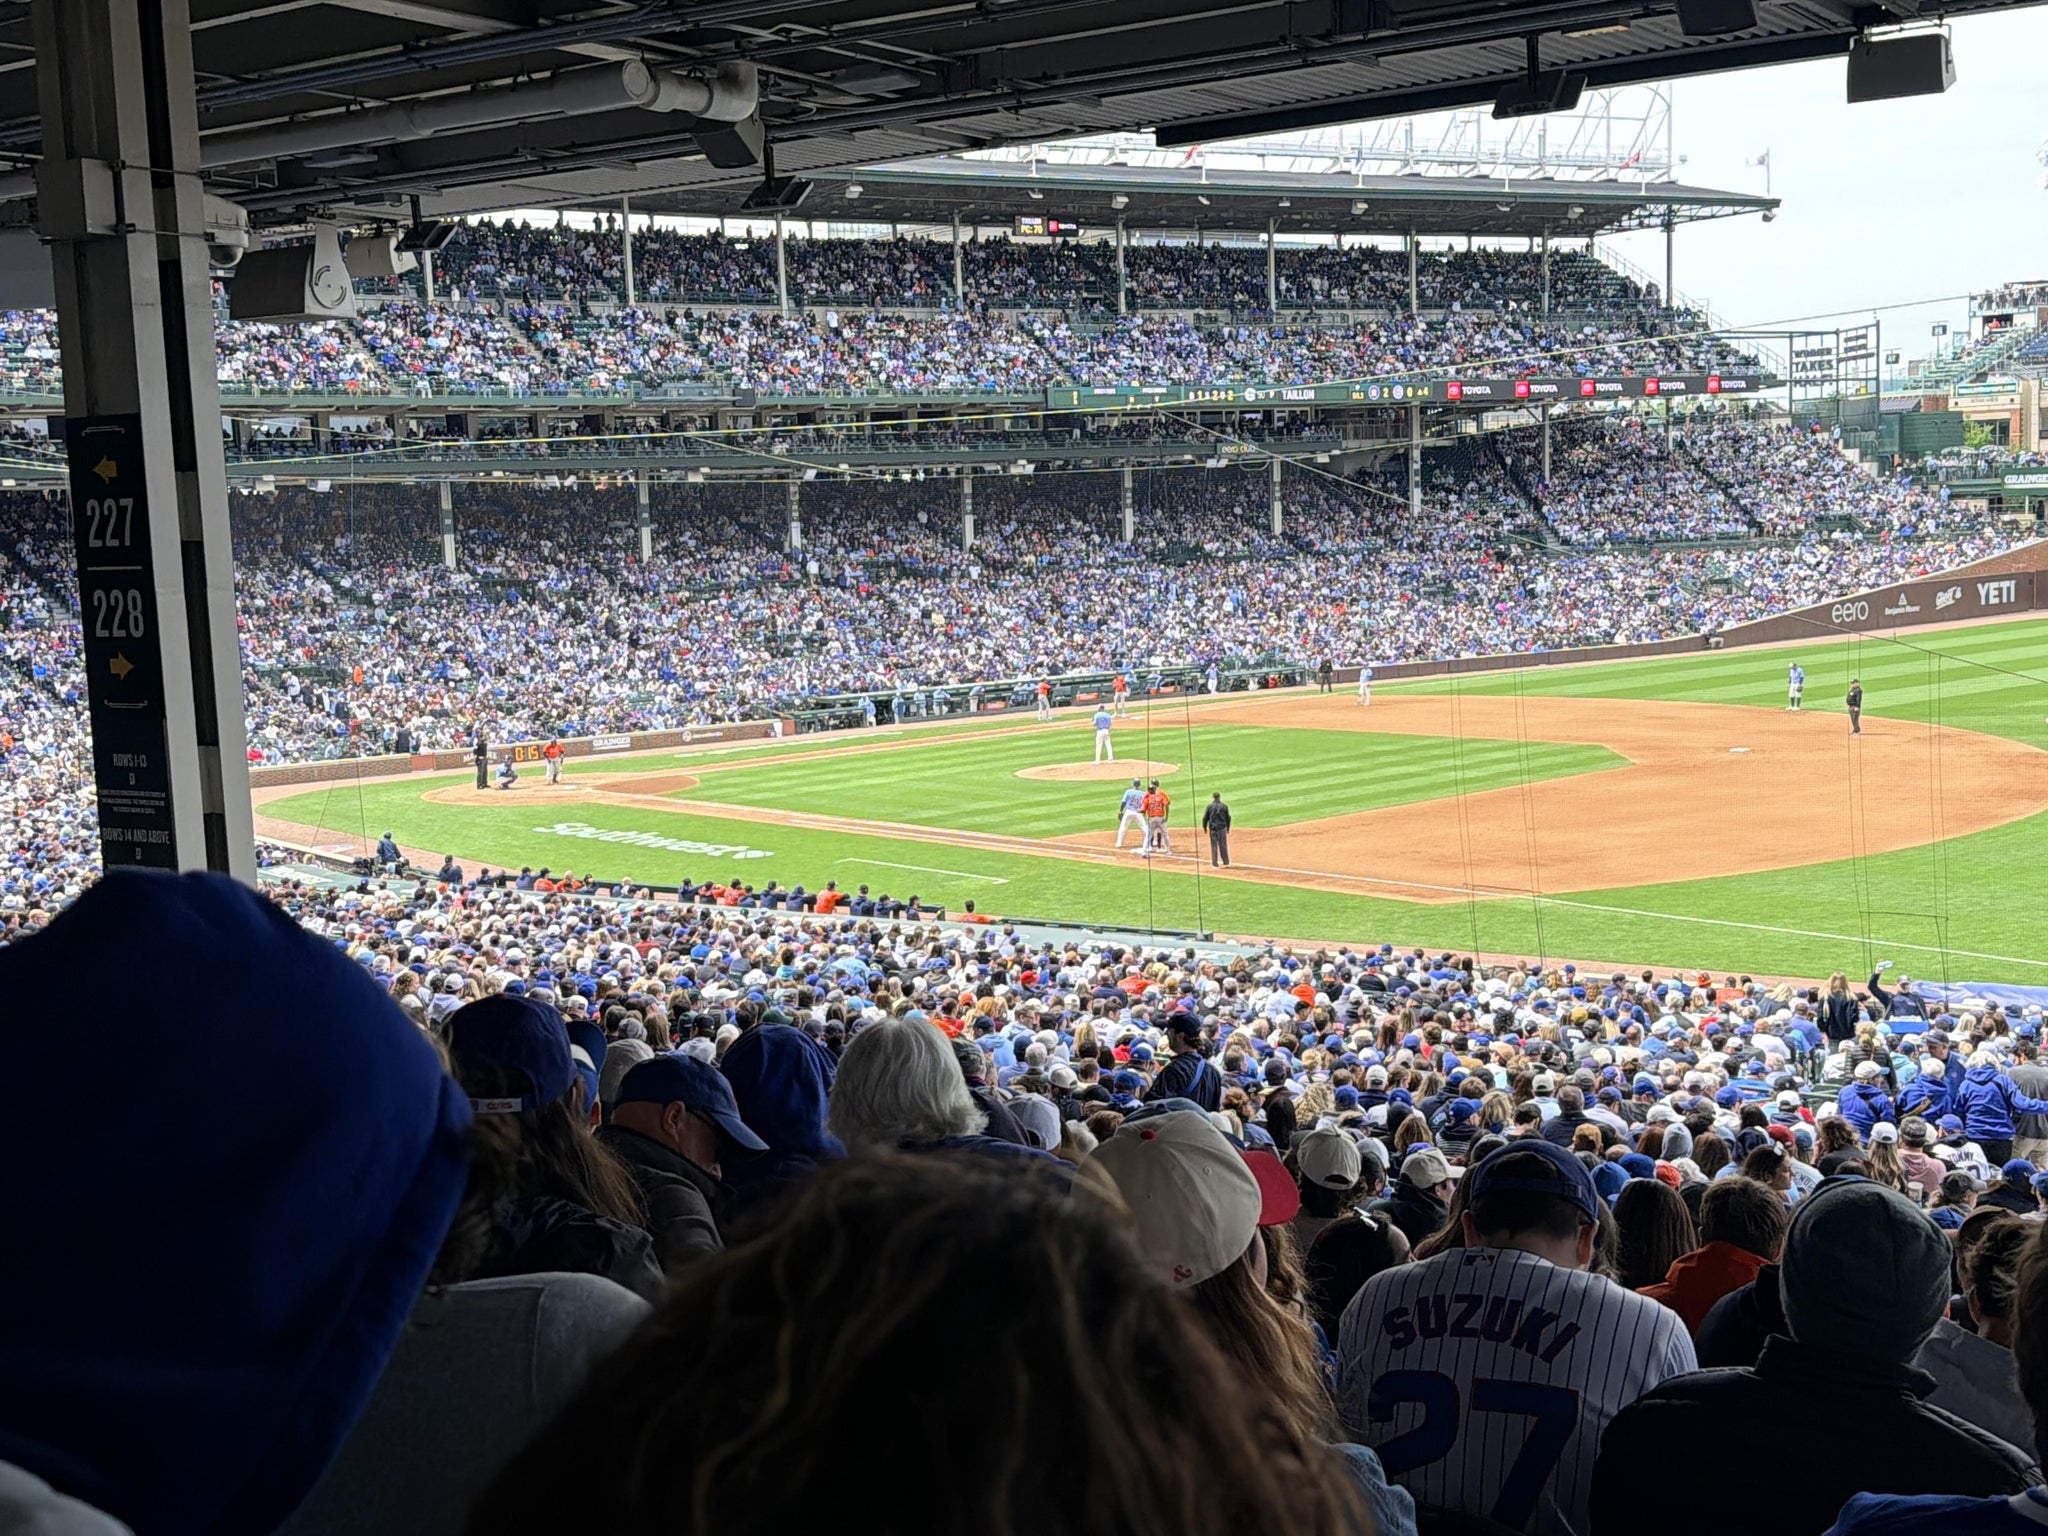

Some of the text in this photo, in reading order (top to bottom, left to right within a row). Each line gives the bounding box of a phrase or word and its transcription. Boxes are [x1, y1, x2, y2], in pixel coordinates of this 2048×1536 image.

[1792, 360, 1834, 372] TAKES
[1462, 385, 1491, 395] TOYOTA
[1530, 384, 1558, 393] TOYOTA
[1595, 382, 1623, 392] TOYOTA
[1659, 381, 1686, 391] TOYOTA
[1720, 380, 1747, 389] TOYOTA
[1212, 390, 1219, 401] 2
[1281, 389, 1315, 400] TAILLON
[1383, 387, 1389, 398] 2
[1407, 386, 1413, 398] 0
[2004, 474, 2048, 484] GRAINGE
[86, 498, 134, 547] 227
[1977, 579, 2016, 606] YETI
[93, 589, 144, 638] 228
[1832, 600, 1869, 623] eero
[592, 737, 631, 747] GRAINGER
[112, 753, 147, 768] ROWS 1-13
[463, 750, 498, 763] MAEE
[102, 827, 124, 842] ROWS
[133, 828, 148, 843] AND
[148, 829, 170, 844] ABOVE
[532, 822, 751, 857] Southwest
[1947, 1151, 1974, 1164] TOMMY
[1383, 1293, 1582, 1364] SUZUKI
[1368, 1369, 1580, 1533] 27
